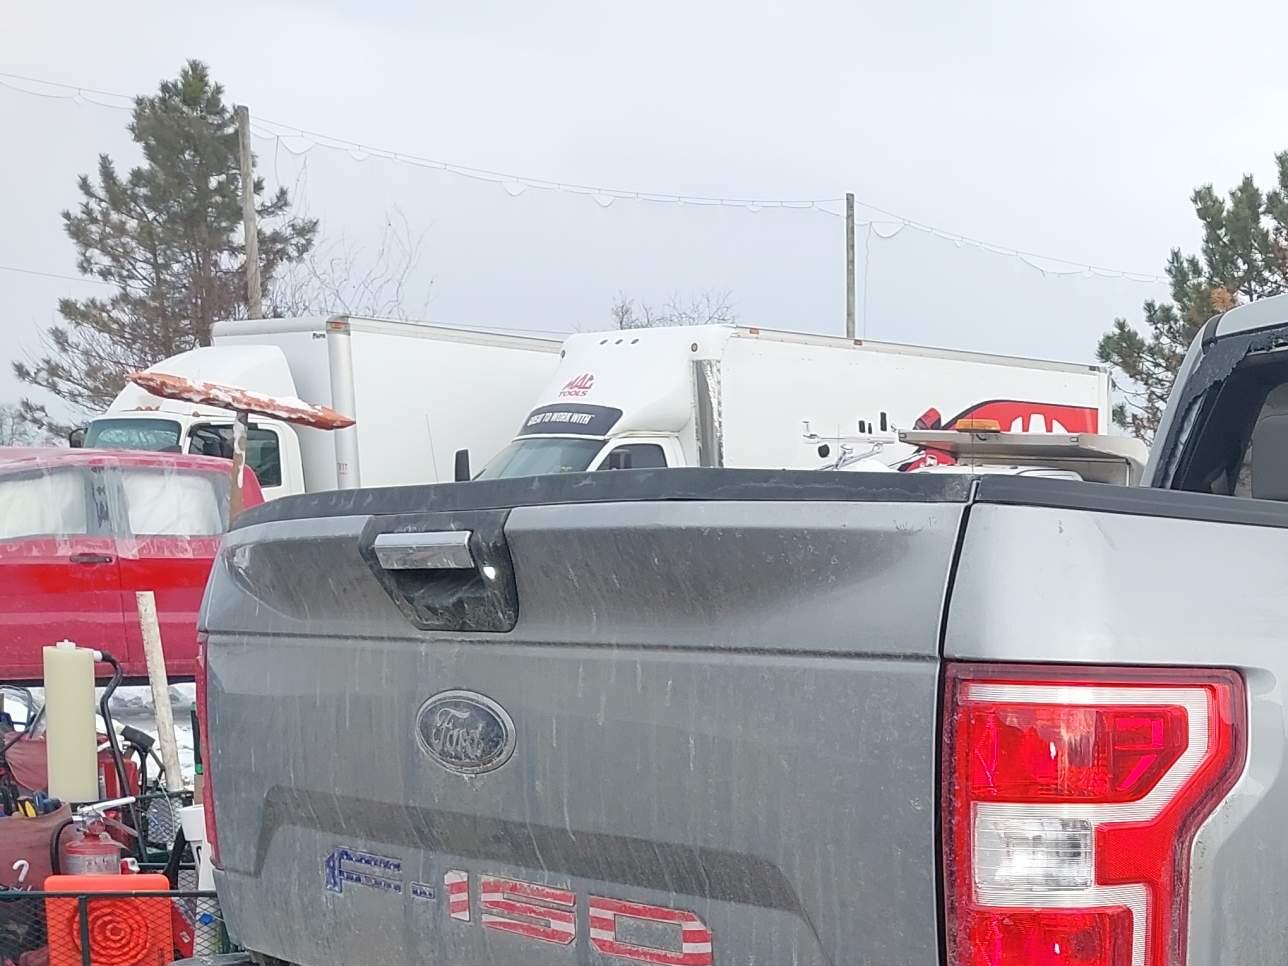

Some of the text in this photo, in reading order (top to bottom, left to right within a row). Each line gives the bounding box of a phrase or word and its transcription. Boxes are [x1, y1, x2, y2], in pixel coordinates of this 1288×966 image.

[562, 373, 594, 390] MAC
[558, 390, 588, 398] TOOLS
[431, 707, 486, 758] Ford
